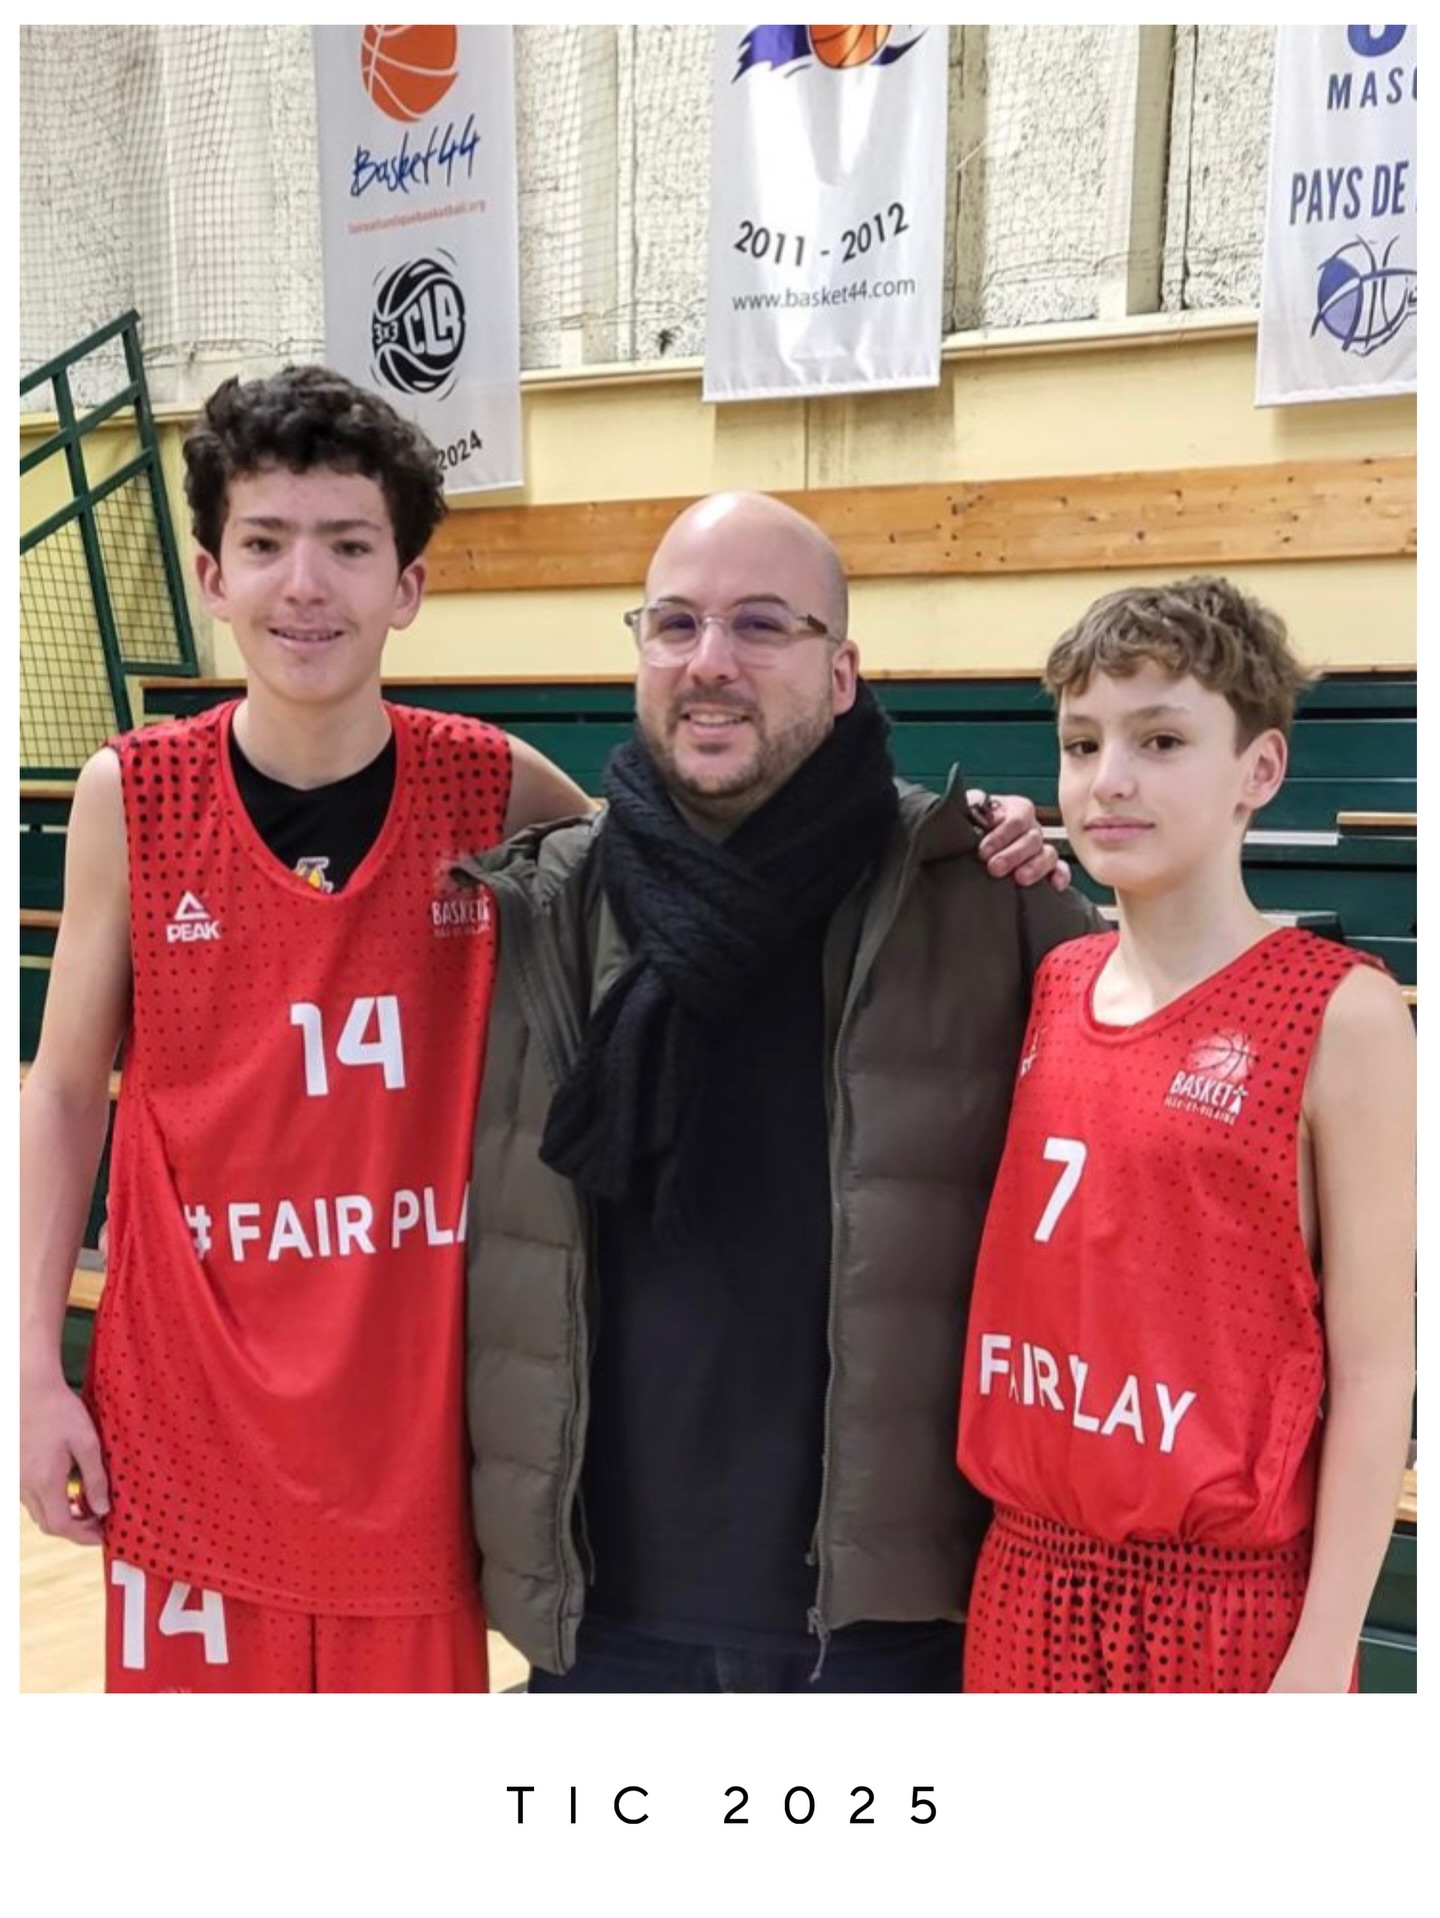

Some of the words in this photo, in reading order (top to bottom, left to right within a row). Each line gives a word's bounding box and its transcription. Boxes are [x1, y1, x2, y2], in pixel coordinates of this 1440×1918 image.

[1289, 166, 1363, 225] PAYS
[1370, 160, 1409, 216] DE
[733, 219, 806, 267] 2011
[841, 201, 910, 263] 2012
[731, 276, 917, 312] www.basket44.com
[434, 428, 483, 472] 2024
[166, 922, 221, 943] PEAK
[290, 995, 406, 1096] 14
[1168, 1069, 1234, 1108] BASKET
[1033, 1136, 1088, 1244] 7
[227, 1194, 377, 1263] FAIR
[111, 1559, 230, 1671] 14
